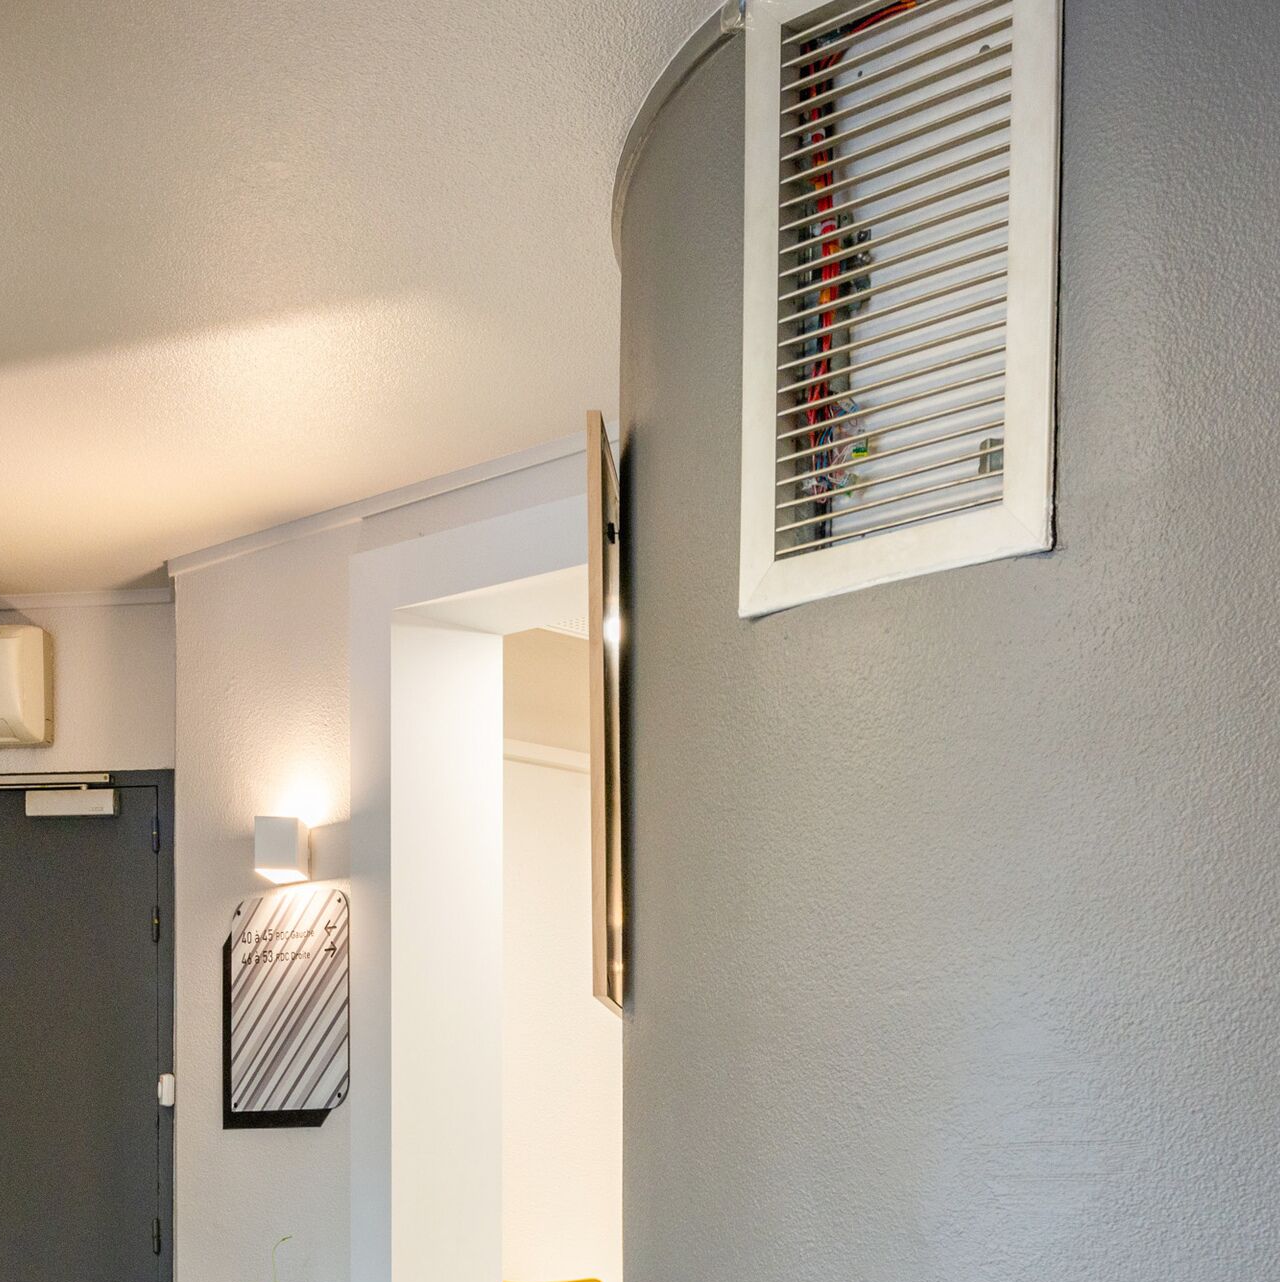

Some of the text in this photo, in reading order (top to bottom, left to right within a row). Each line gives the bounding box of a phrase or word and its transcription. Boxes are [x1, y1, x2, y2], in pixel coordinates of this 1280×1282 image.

[241, 931, 252, 944] 40
[262, 929, 273, 941] 45
[241, 953, 252, 965] 46
[262, 950, 272, 963] 53
